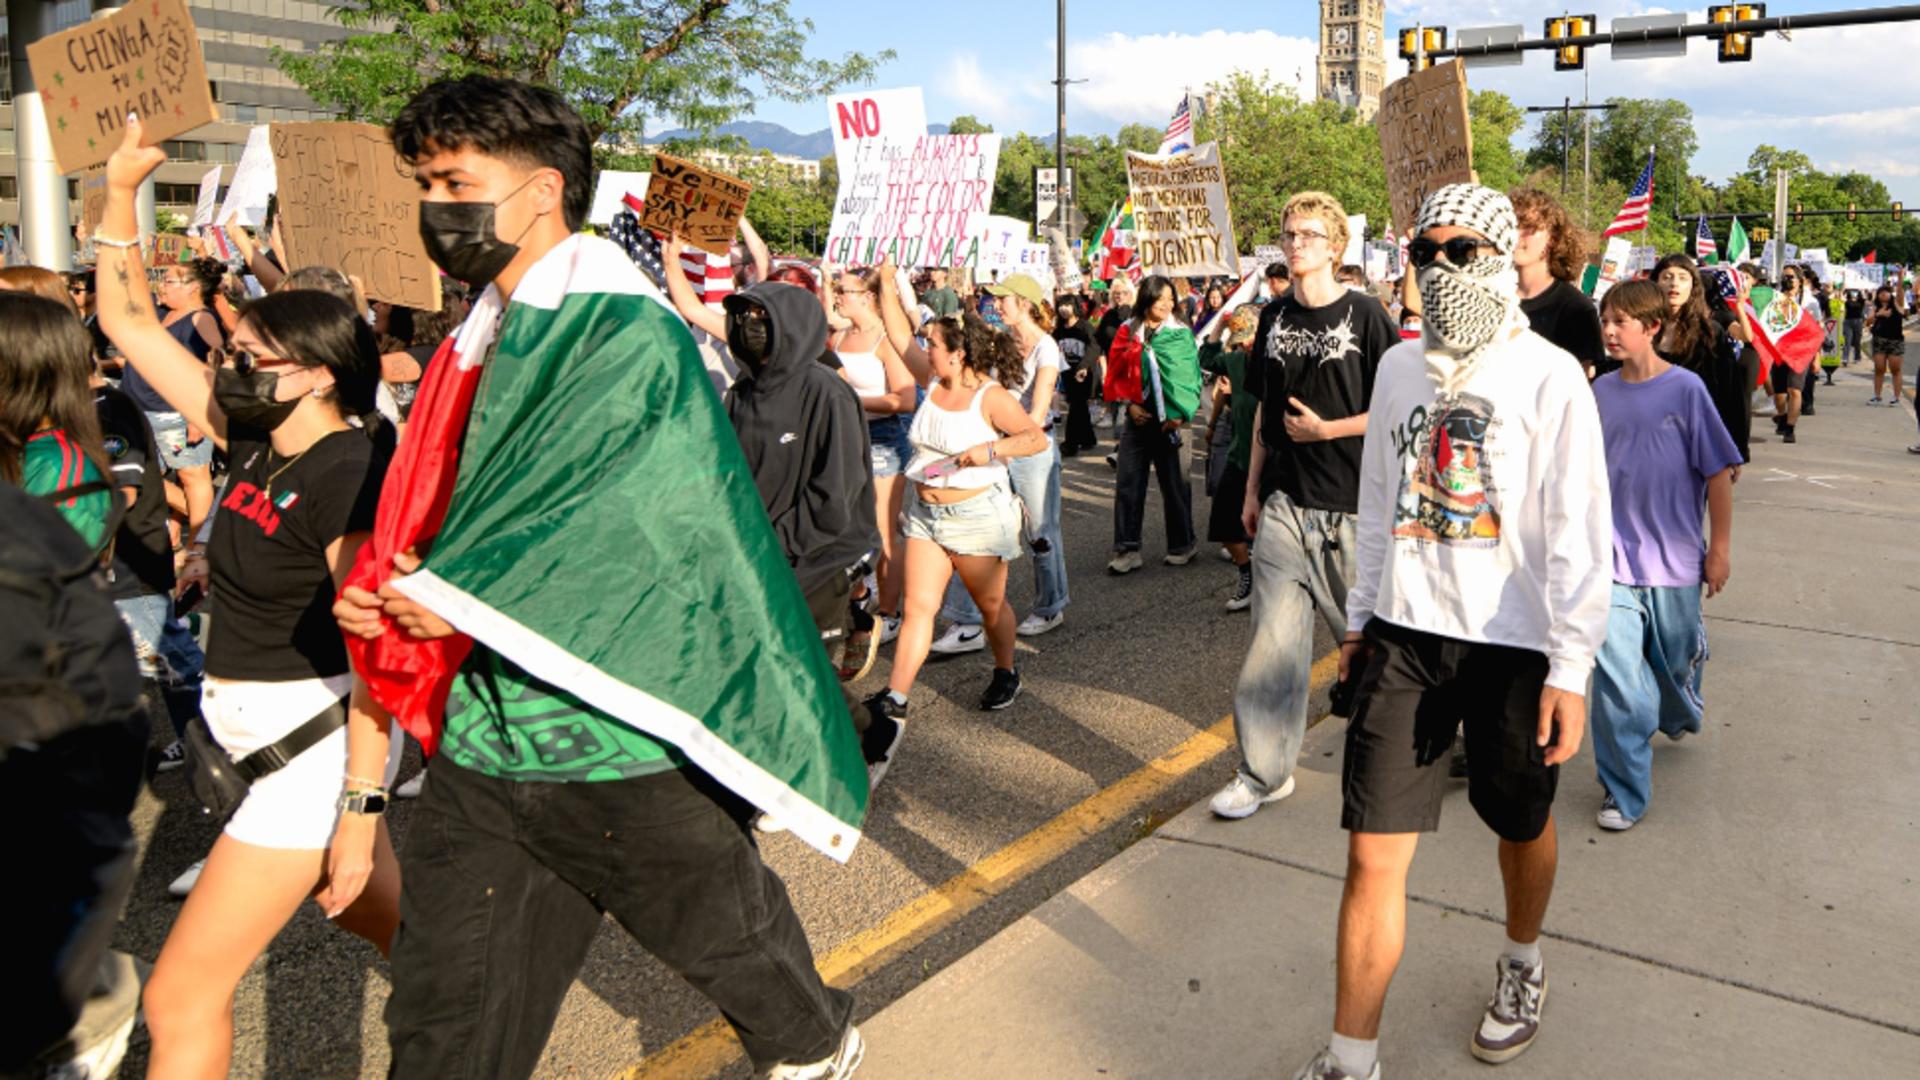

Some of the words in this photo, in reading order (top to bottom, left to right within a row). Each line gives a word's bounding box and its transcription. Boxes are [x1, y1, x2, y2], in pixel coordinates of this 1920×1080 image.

[67, 17, 155, 74] CHINGA
[111, 72, 130, 92] tu
[96, 87, 167, 137] MIGRA
[836, 98, 880, 140] NO
[912, 132, 981, 162] ALWAYS
[383, 201, 411, 220] NOT
[645, 193, 697, 220] SAY
[884, 179, 923, 215] THE
[924, 178, 989, 215] COLOR
[1133, 191, 1153, 208] NOT
[1186, 207, 1216, 230] FOR
[924, 235, 979, 268] MAGA
